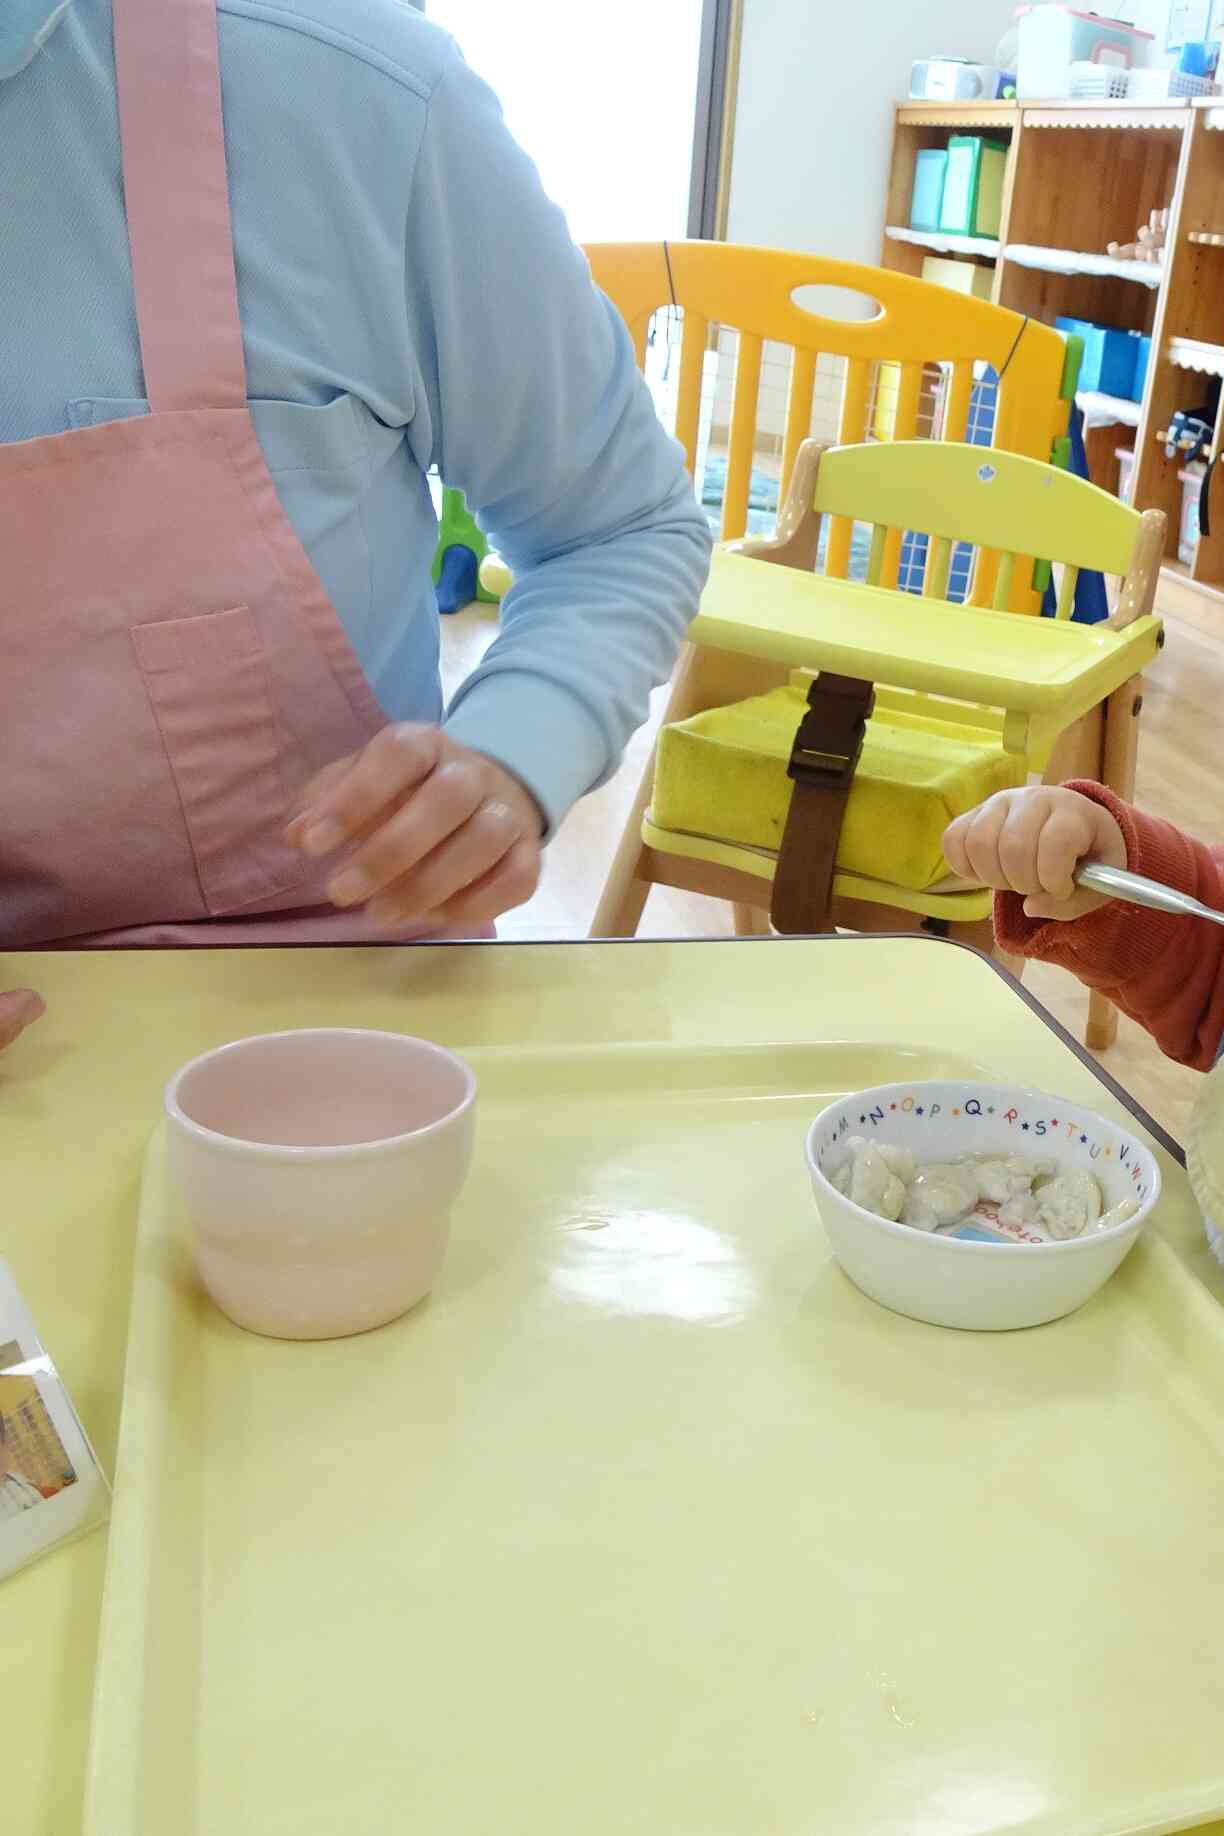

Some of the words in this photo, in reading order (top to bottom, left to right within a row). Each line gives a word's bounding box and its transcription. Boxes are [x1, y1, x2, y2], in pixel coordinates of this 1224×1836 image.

[870, 1106, 885, 1126] N
[901, 1096, 914, 1112] O
[929, 1103, 941, 1118] P
[965, 1099, 983, 1116] Q
[1003, 1108, 1018, 1125] R
[1034, 1120, 1047, 1136] S
[1067, 1122, 1080, 1137] T
[1089, 1143, 1101, 1159] U
[1119, 1144, 1130, 1160] V
